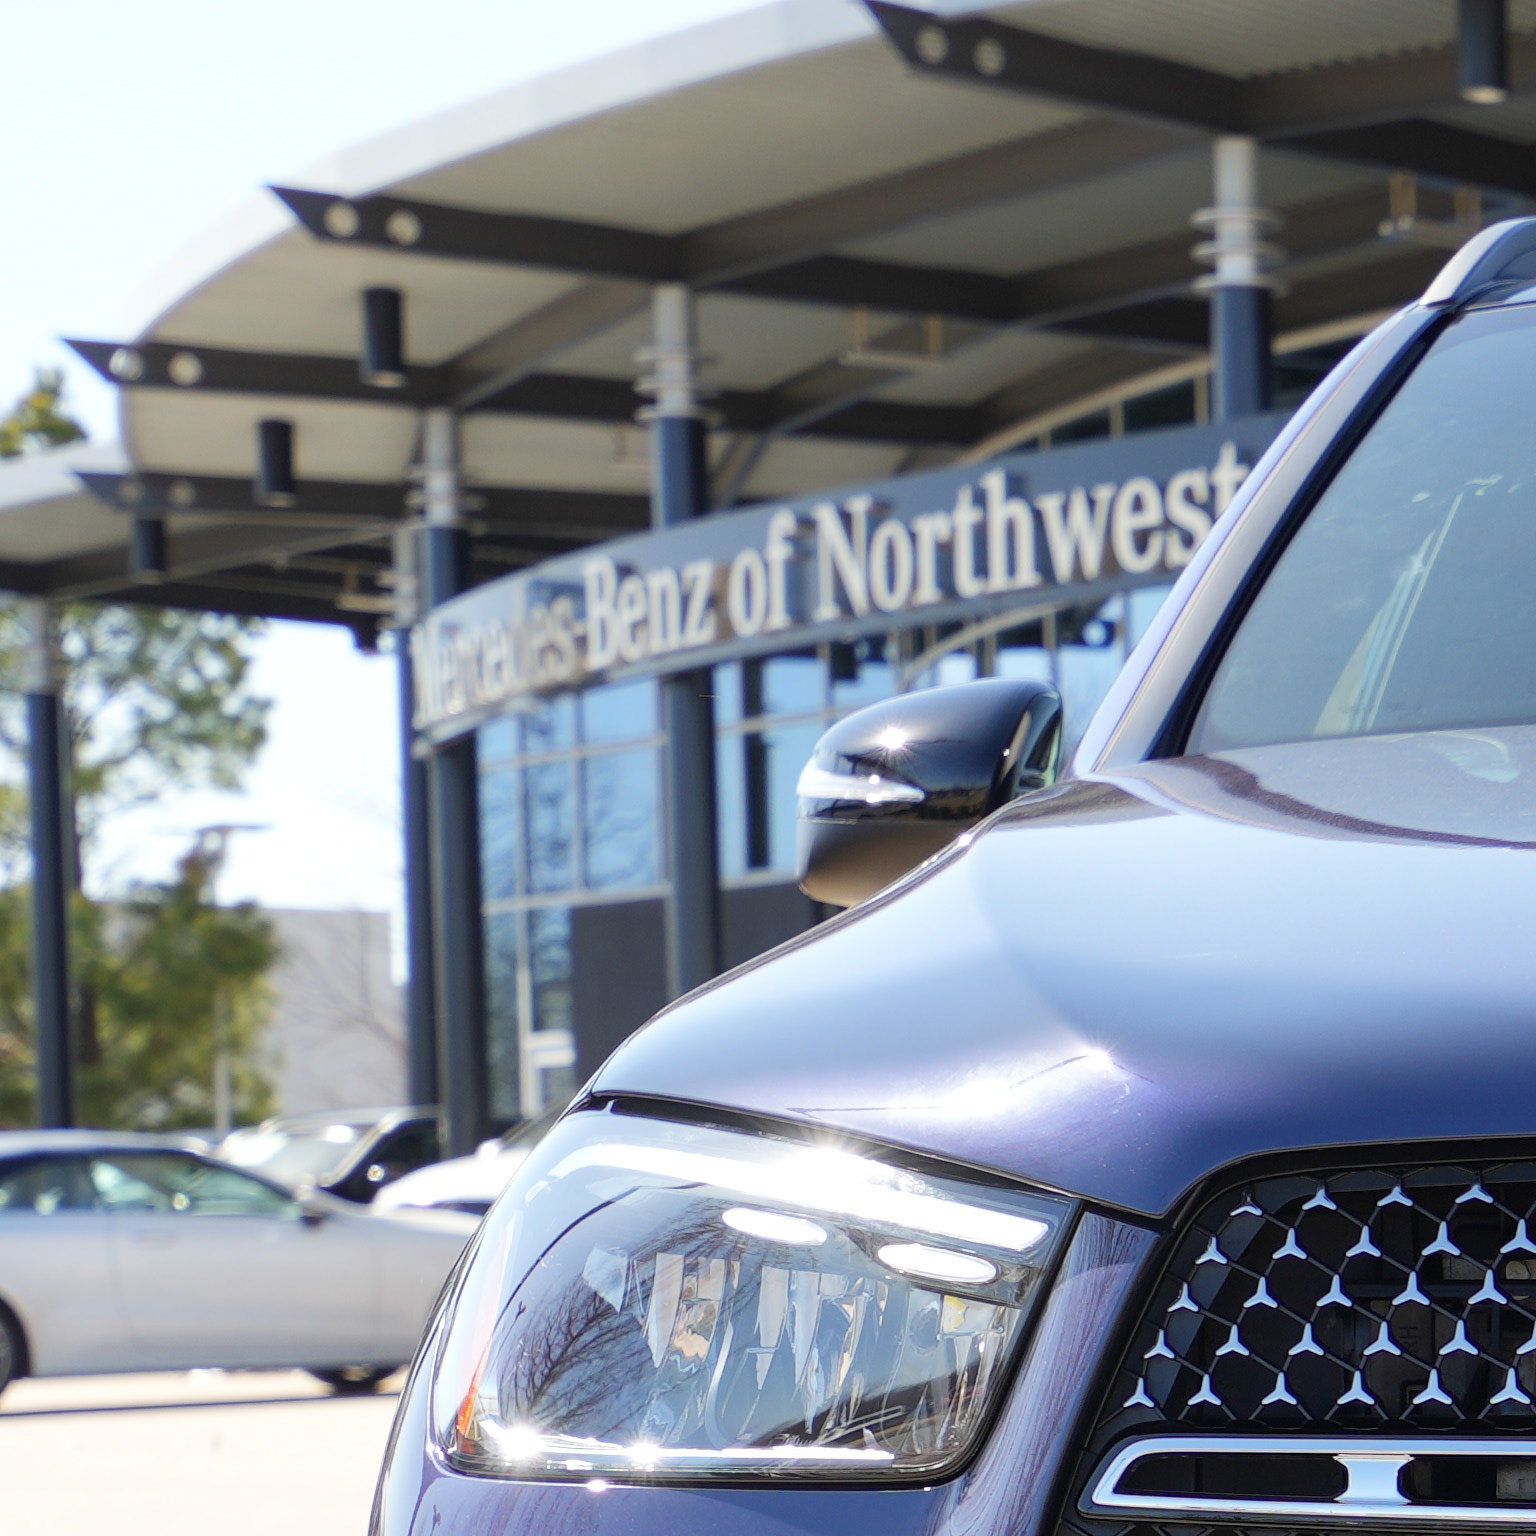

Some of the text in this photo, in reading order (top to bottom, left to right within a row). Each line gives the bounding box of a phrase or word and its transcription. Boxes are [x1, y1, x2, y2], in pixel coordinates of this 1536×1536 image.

[410, 440, 1249, 730] Mercedes-Benz of Northwest
